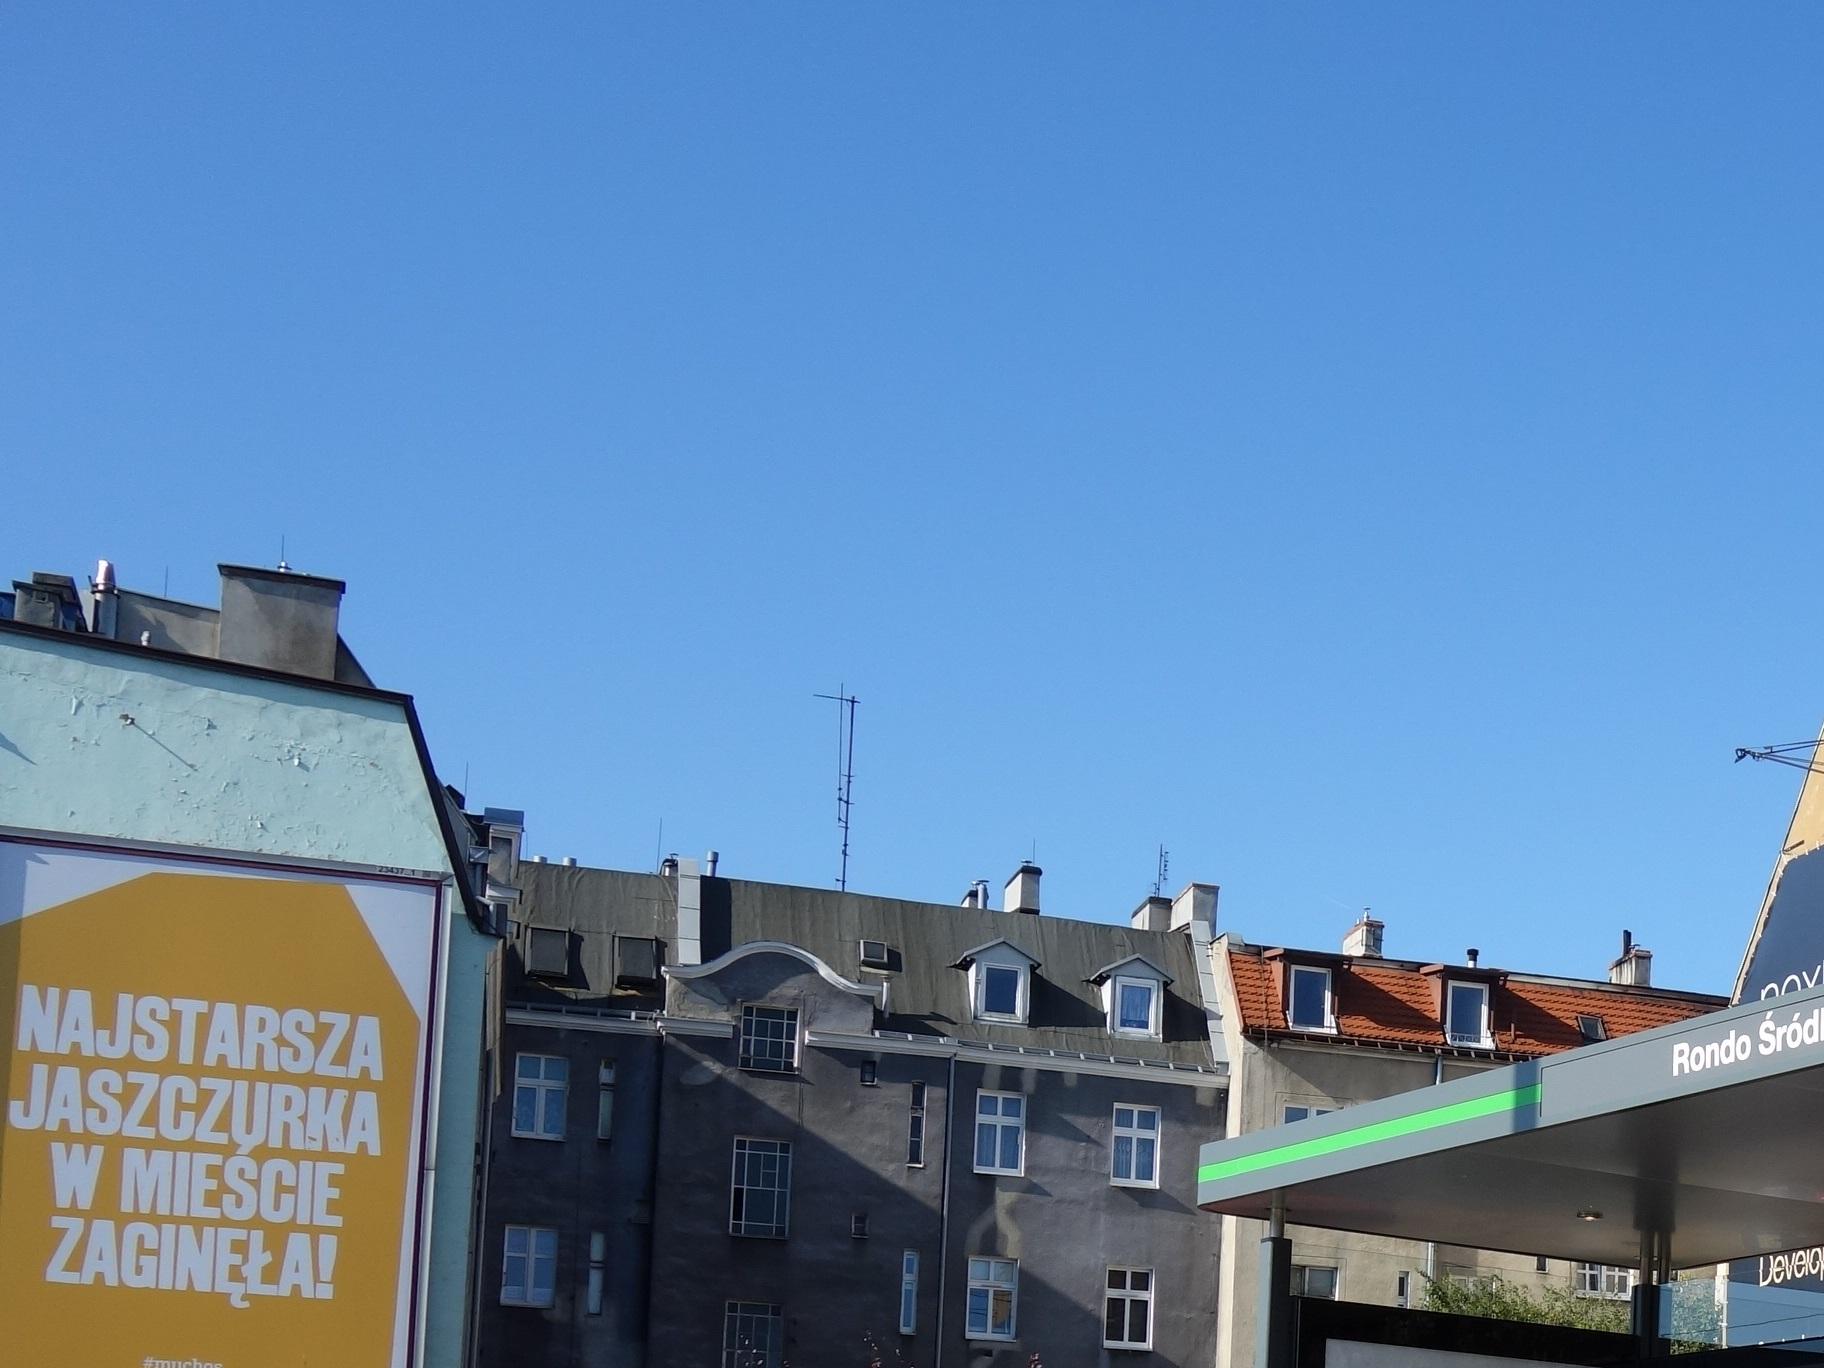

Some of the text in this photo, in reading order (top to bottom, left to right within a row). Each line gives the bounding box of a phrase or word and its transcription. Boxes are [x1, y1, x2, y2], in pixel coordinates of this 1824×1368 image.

[17, 984, 383, 1081] NAJSTARSZA
[1672, 1029, 1752, 1078] Rondo
[7, 1062, 381, 1156] JASZCZURKA
[50, 1142, 344, 1228] W MIEŚCIE
[44, 1216, 336, 1309] ZAGINĘŁA!
